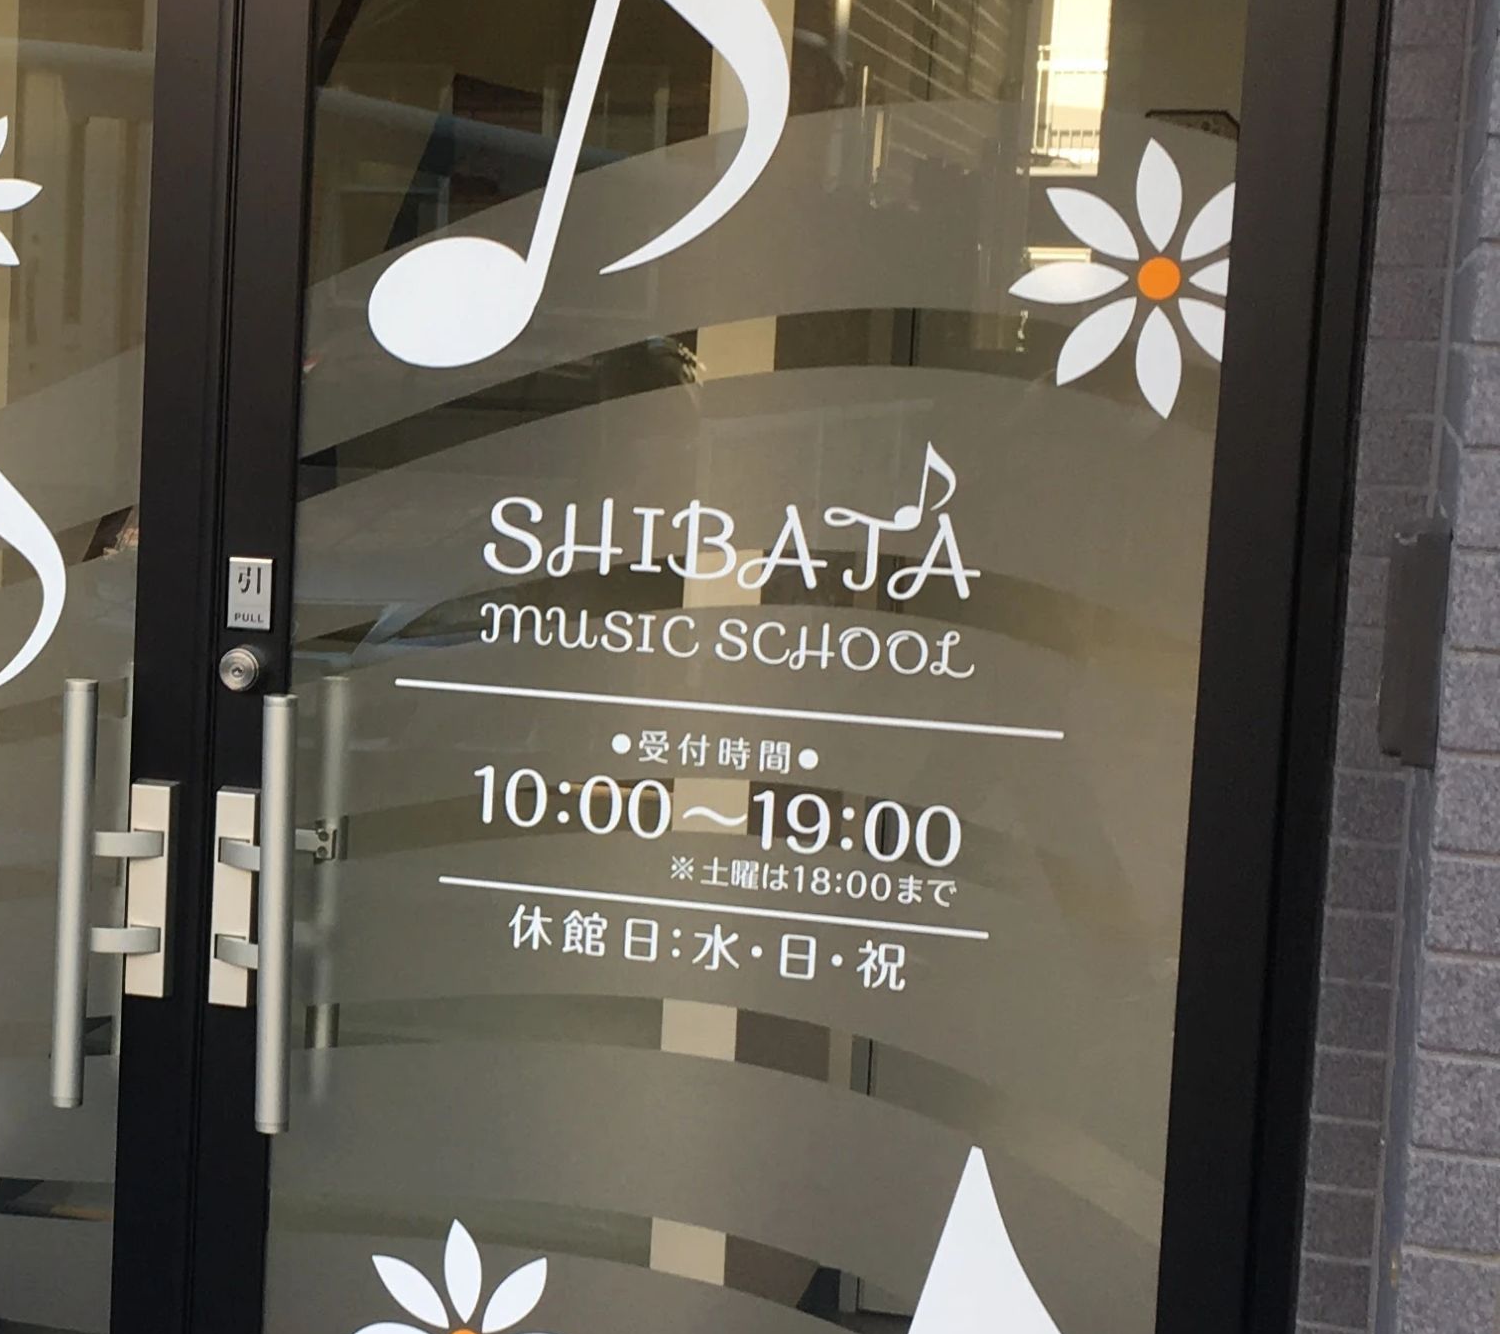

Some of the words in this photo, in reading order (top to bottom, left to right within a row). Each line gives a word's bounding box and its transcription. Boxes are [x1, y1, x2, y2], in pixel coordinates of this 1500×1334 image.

[483, 496, 981, 599] SHIBATA
[237, 566, 262, 594] 引
[234, 612, 264, 623] PULL
[715, 619, 975, 678] SCHOOL
